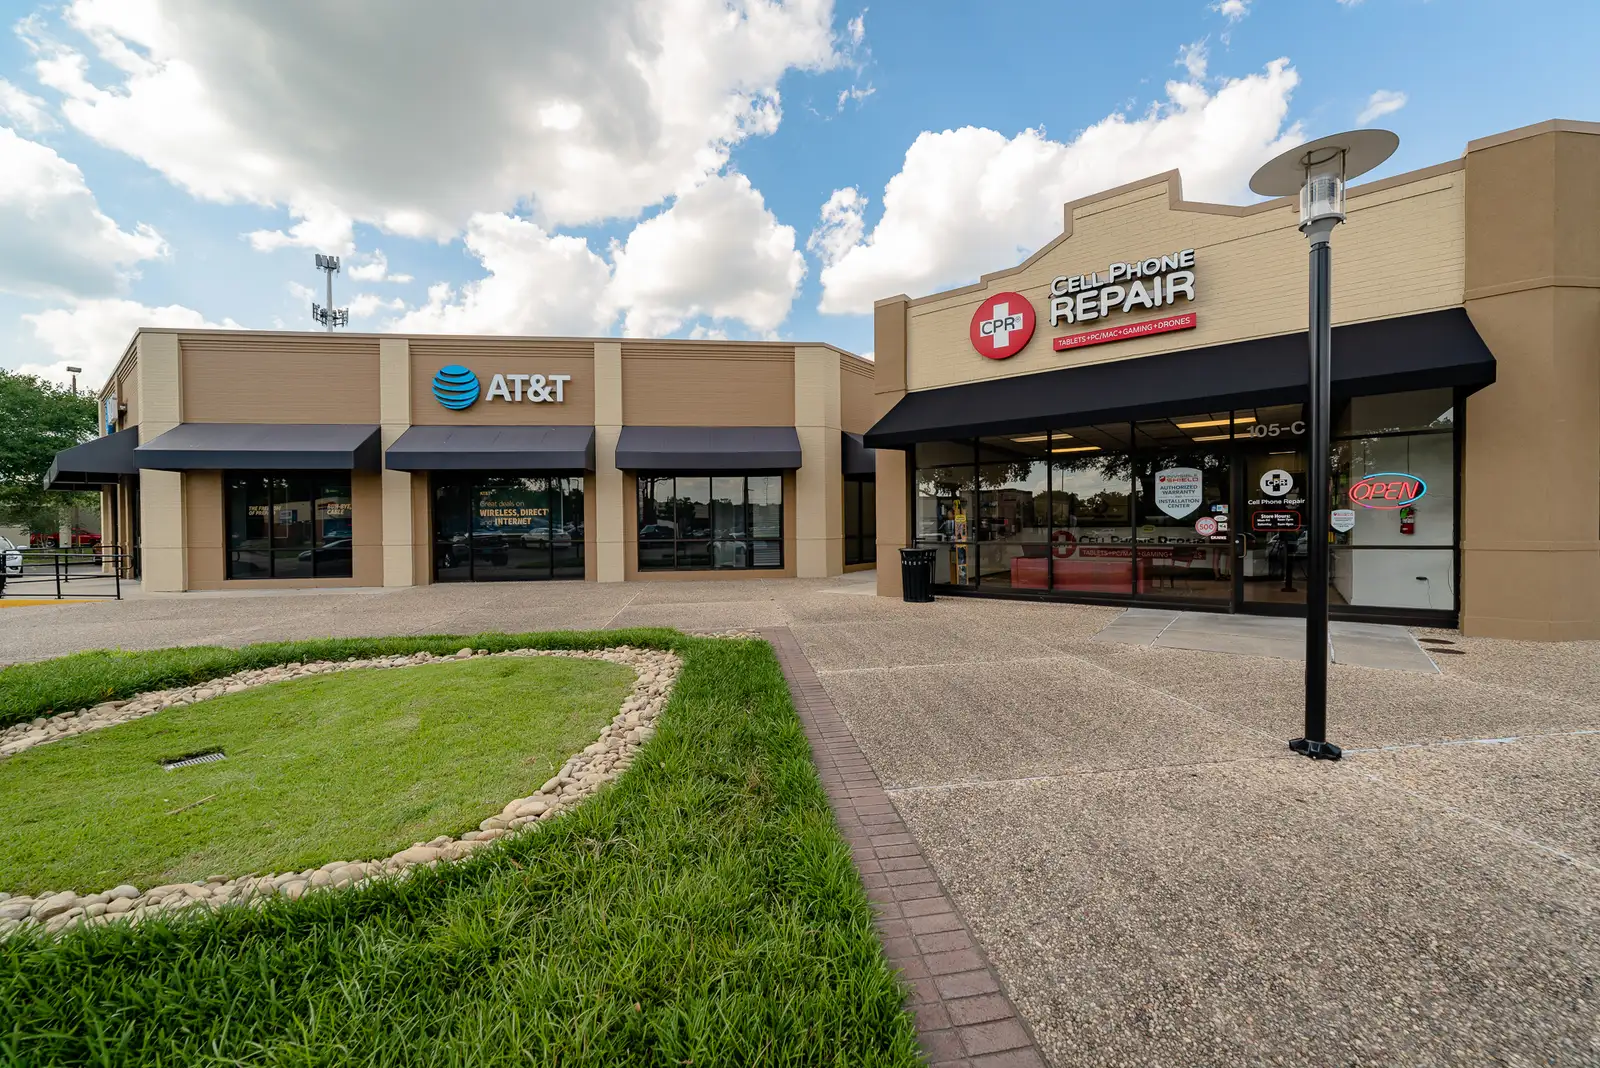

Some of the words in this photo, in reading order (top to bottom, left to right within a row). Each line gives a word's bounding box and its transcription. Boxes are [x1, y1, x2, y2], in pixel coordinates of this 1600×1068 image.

[1050, 272, 1104, 297] CELL
[1109, 249, 1196, 282] PHONE
[1050, 271, 1196, 327] REPAIR
[485, 373, 571, 403] AT&T
[1246, 421, 1306, 438] 105-C
[1353, 481, 1419, 500] OPEN
[1283, 498, 1306, 506] Repair
[479, 508, 520, 517] WIRELESS,
[494, 517, 532, 525] INTERNET
